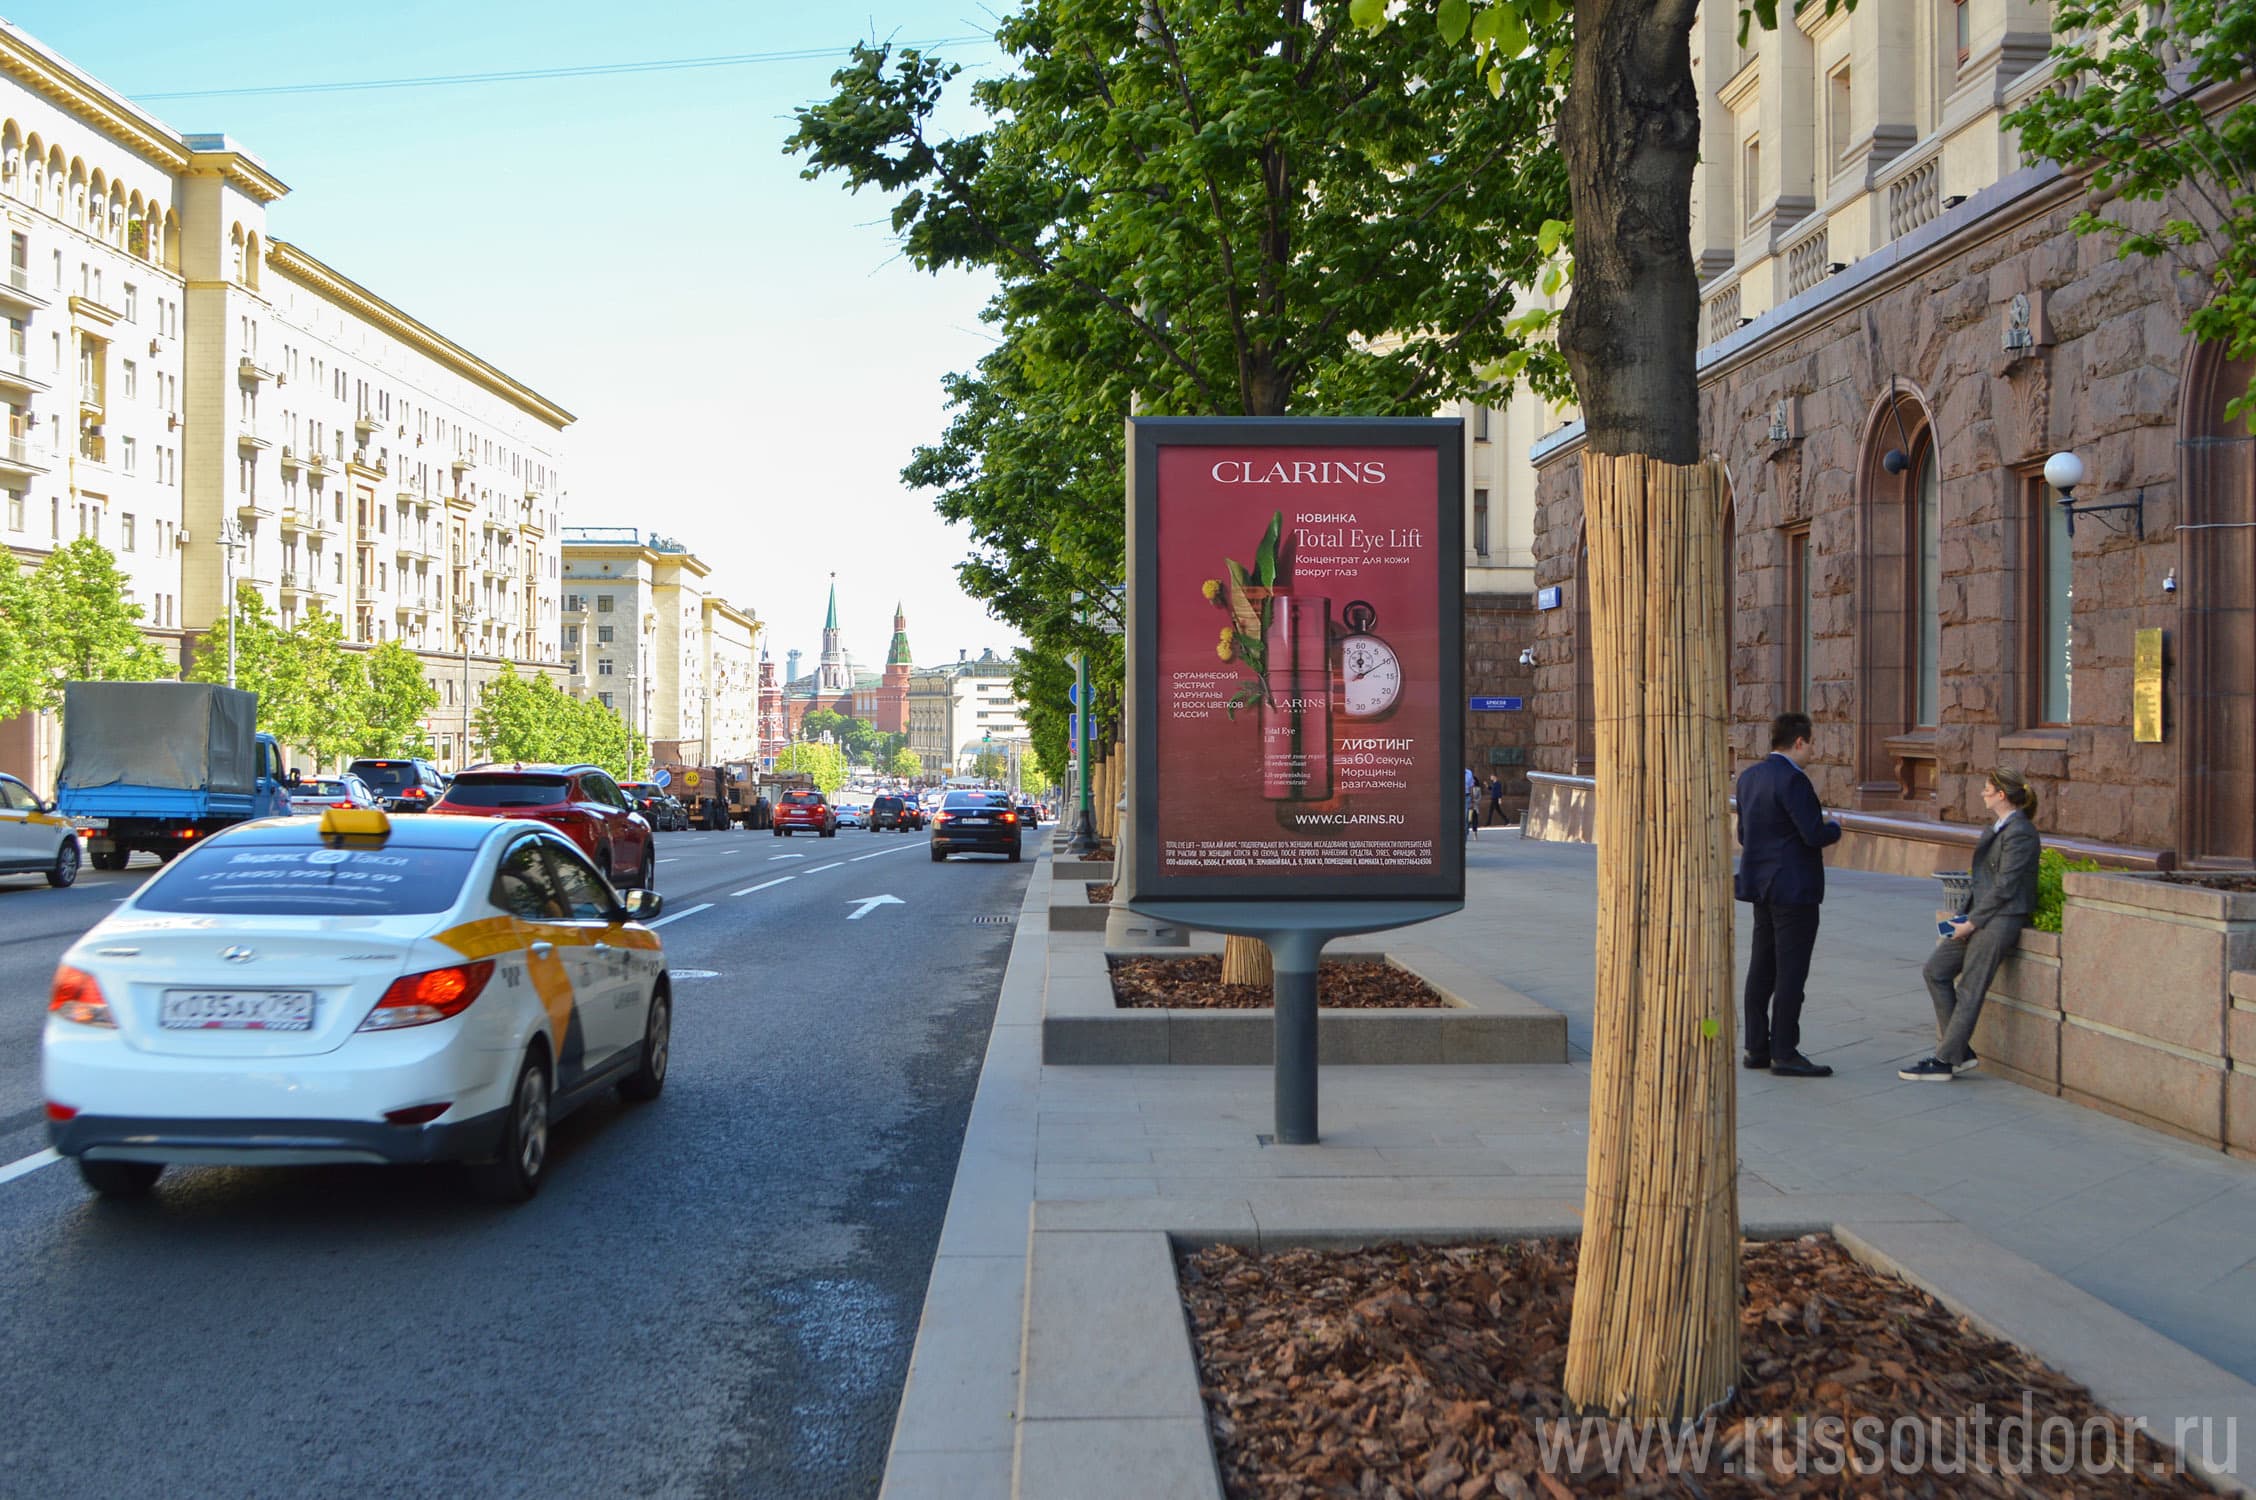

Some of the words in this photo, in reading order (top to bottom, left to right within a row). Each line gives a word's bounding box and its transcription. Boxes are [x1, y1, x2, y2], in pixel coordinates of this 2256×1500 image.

[1211, 461, 1386, 484] CLARINS
[1296, 513, 1357, 523] НОВИНКА
[1295, 529, 1343, 548] Total
[1351, 529, 1384, 553] Eye
[1390, 528, 1423, 548] Lift
[1295, 554, 1359, 565] Концентрат
[1363, 556, 1381, 565] для
[1384, 556, 1410, 564] кожи
[1295, 568, 1332, 578] вокруг
[1335, 568, 1358, 577] глаз
[1173, 671, 1239, 680] ОРГАНИЧЕСКИЙ
[1341, 739, 1414, 751] ЛИФТИНГ
[1341, 756, 1353, 765] за
[1355, 753, 1374, 765] 60
[1341, 768, 1396, 778] Морщины
[687, 774, 698, 783] 40
[1341, 780, 1407, 790] разглажены
[1295, 814, 1405, 825] WWW.CLARINS.RU
